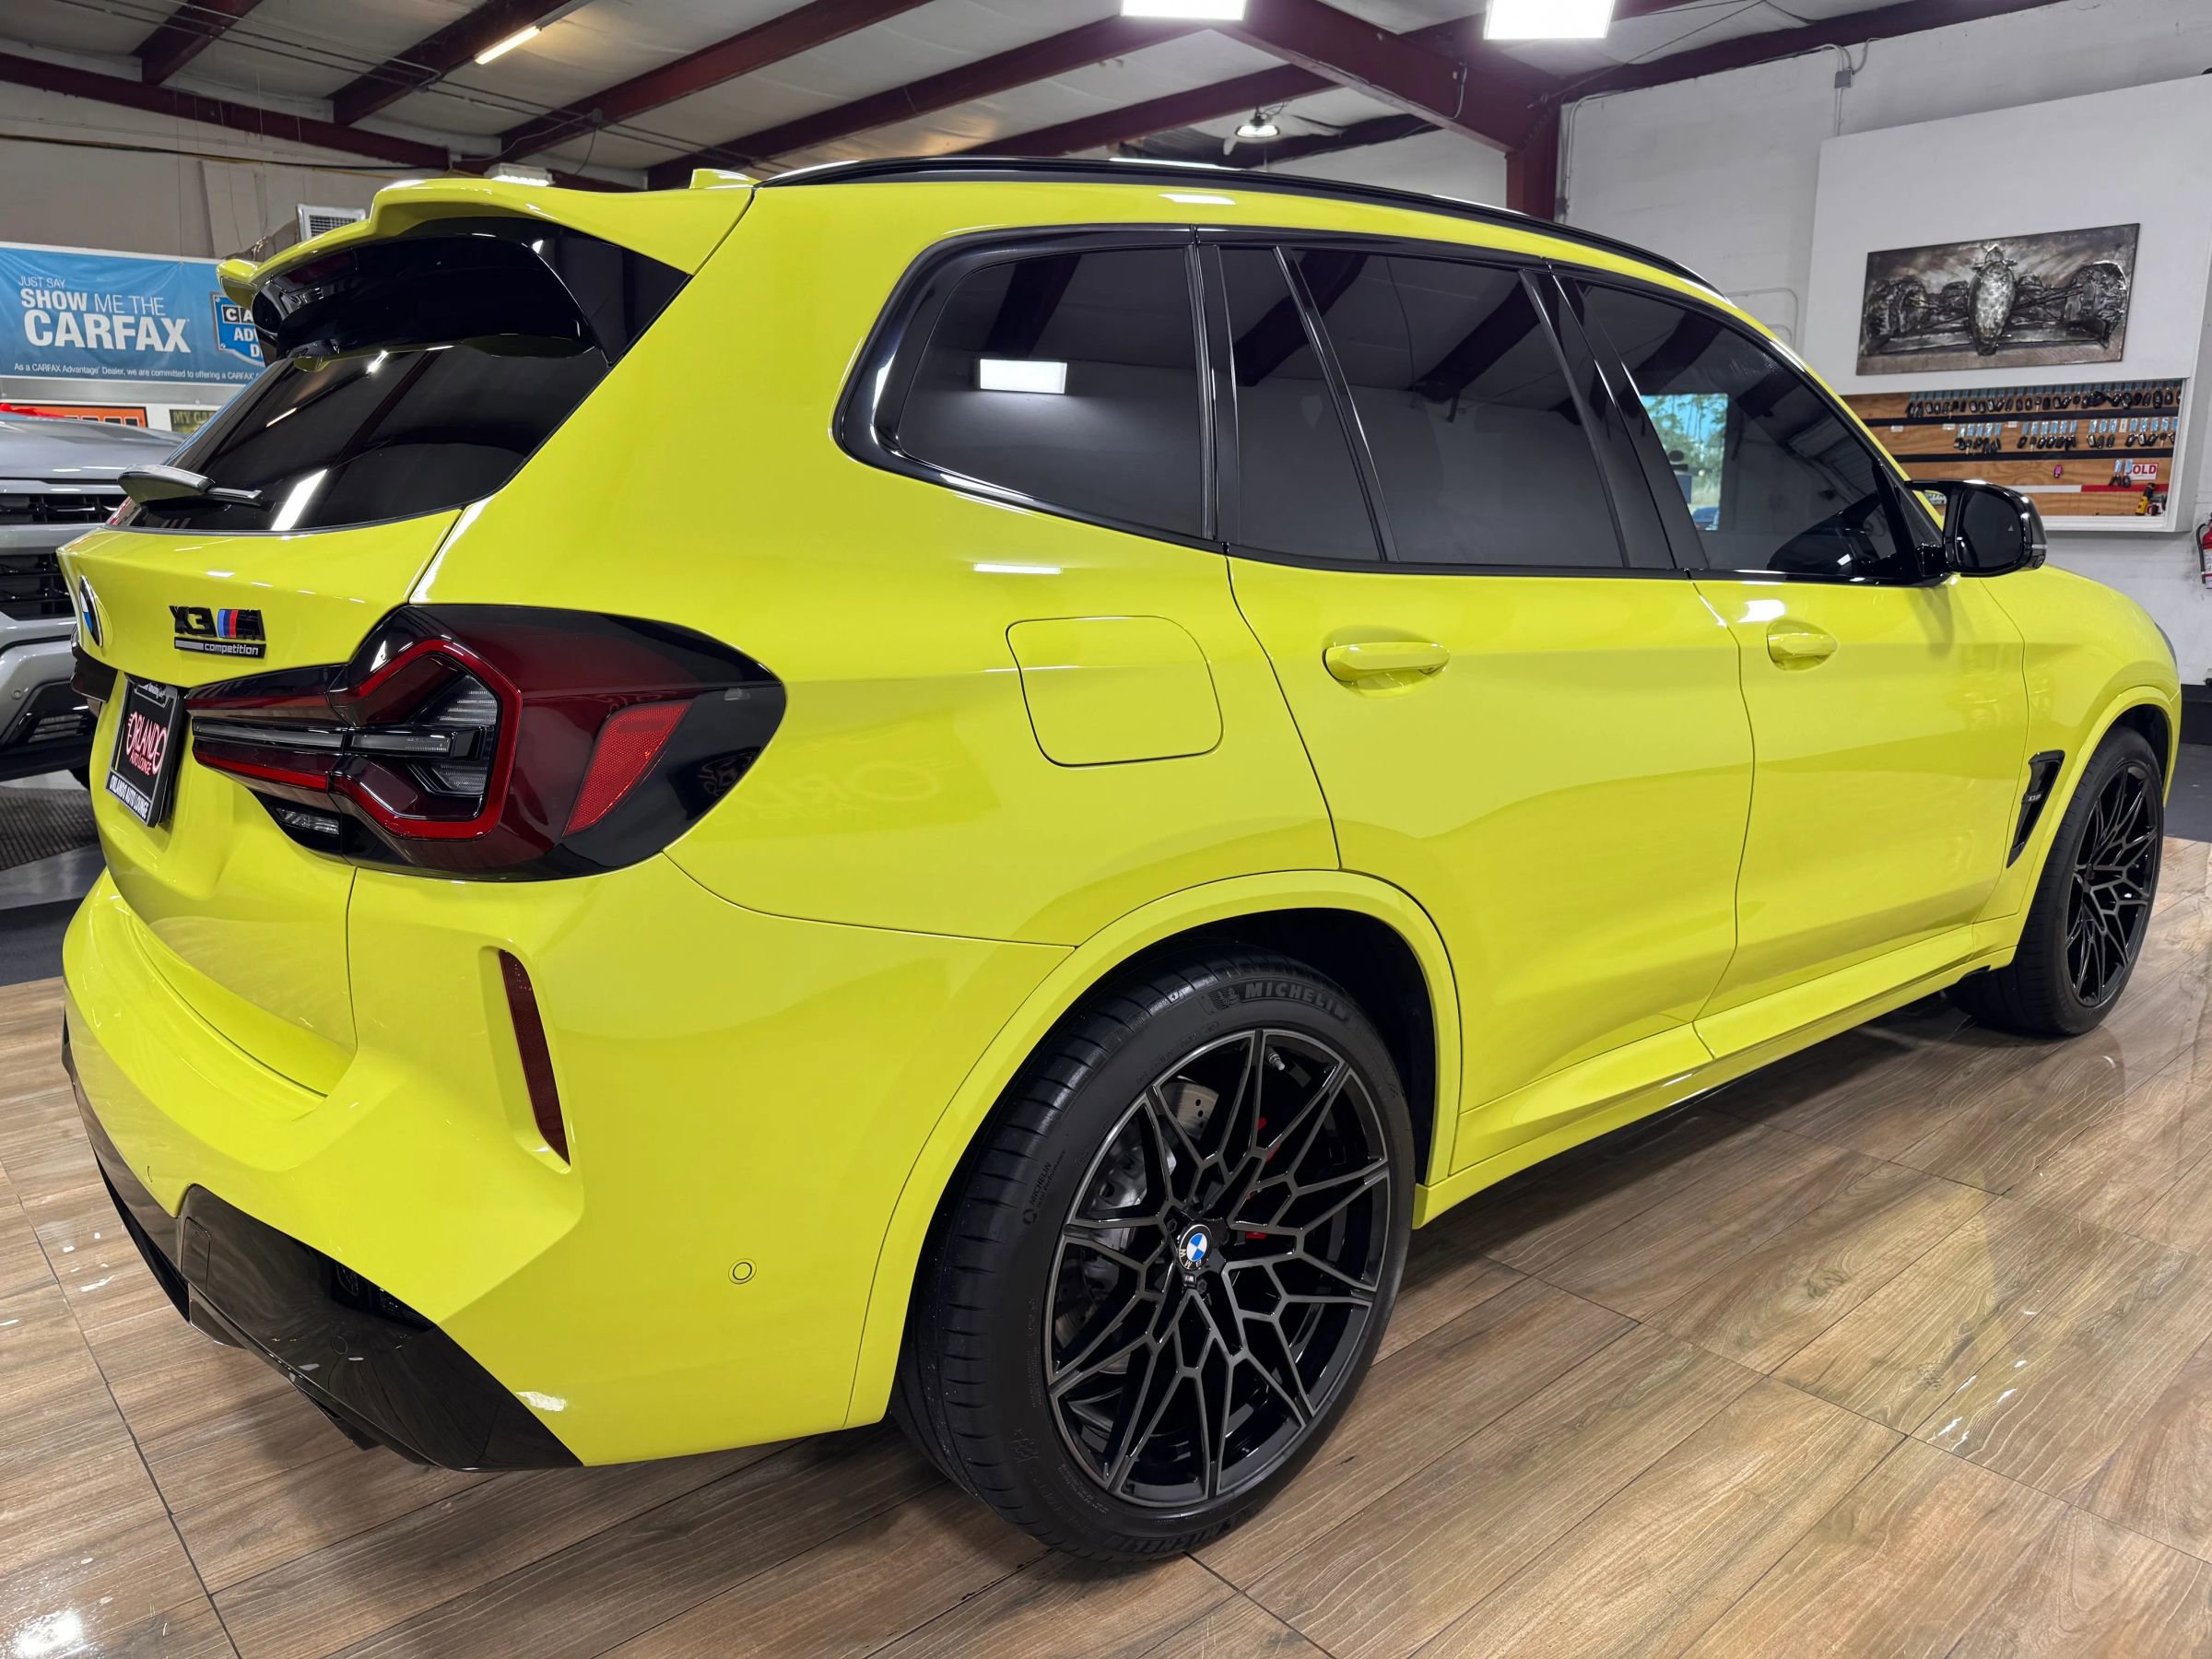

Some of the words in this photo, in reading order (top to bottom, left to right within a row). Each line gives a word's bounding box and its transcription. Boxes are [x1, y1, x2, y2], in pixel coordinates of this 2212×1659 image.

[18, 276, 44, 288] JUST
[46, 277, 66, 289] SAY
[20, 288, 88, 312] SHOW
[94, 293, 125, 314] ME
[129, 295, 167, 316] THE
[23, 309, 192, 353] CARFAX
[14, 362, 24, 371] As
[31, 363, 62, 372] CARFAX
[101, 366, 126, 376] Dealer,
[150, 369, 185, 378] committed
[187, 370, 194, 378] to
[172, 411, 191, 424] MY
[204, 642, 259, 655] competition
[126, 711, 168, 775] ORLANDO
[1245, 982, 1348, 1020] MICHELIN
[1029, 1160, 1053, 1206] MICHELIN
